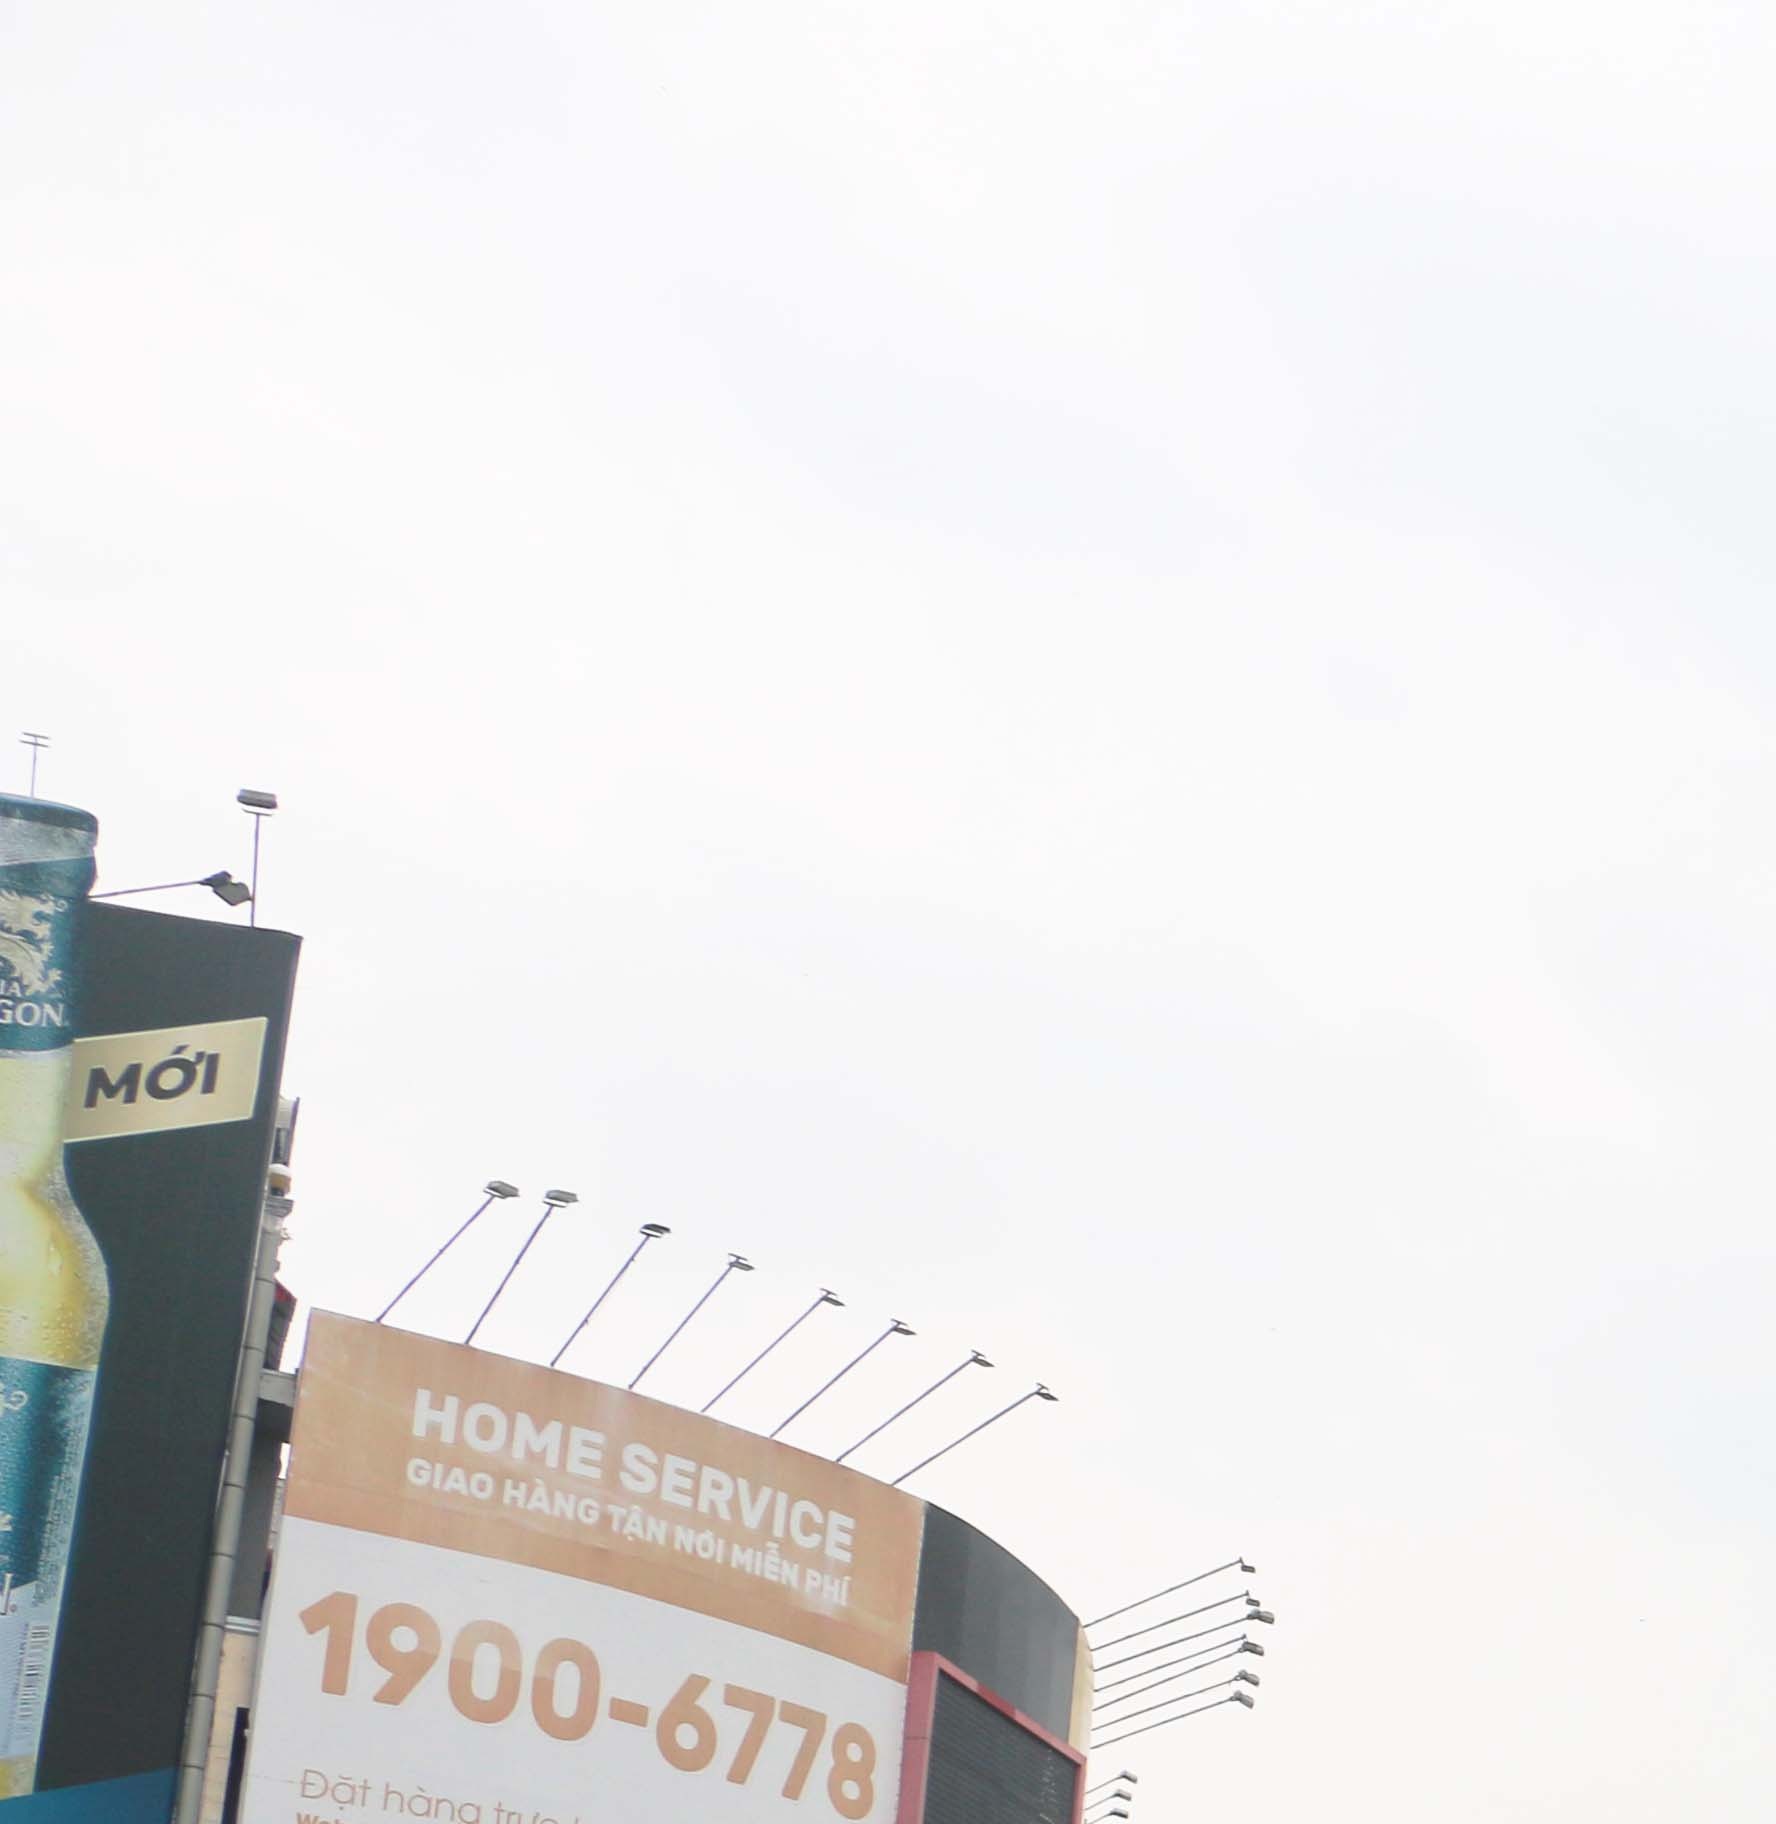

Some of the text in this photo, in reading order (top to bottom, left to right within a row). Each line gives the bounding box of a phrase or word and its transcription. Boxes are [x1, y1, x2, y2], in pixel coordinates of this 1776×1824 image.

[83, 1044, 220, 1109] MỚI
[406, 1457, 495, 1501] GIAO
[502, 1478, 600, 1525] HÀNG
[607, 1504, 668, 1547] TẬN
[804, 1567, 852, 1606] PHÍ
[411, 1388, 856, 1564] HOME SERVICE
[298, 1590, 878, 1822] 1900-6778
[300, 1769, 372, 1813] Đặt
